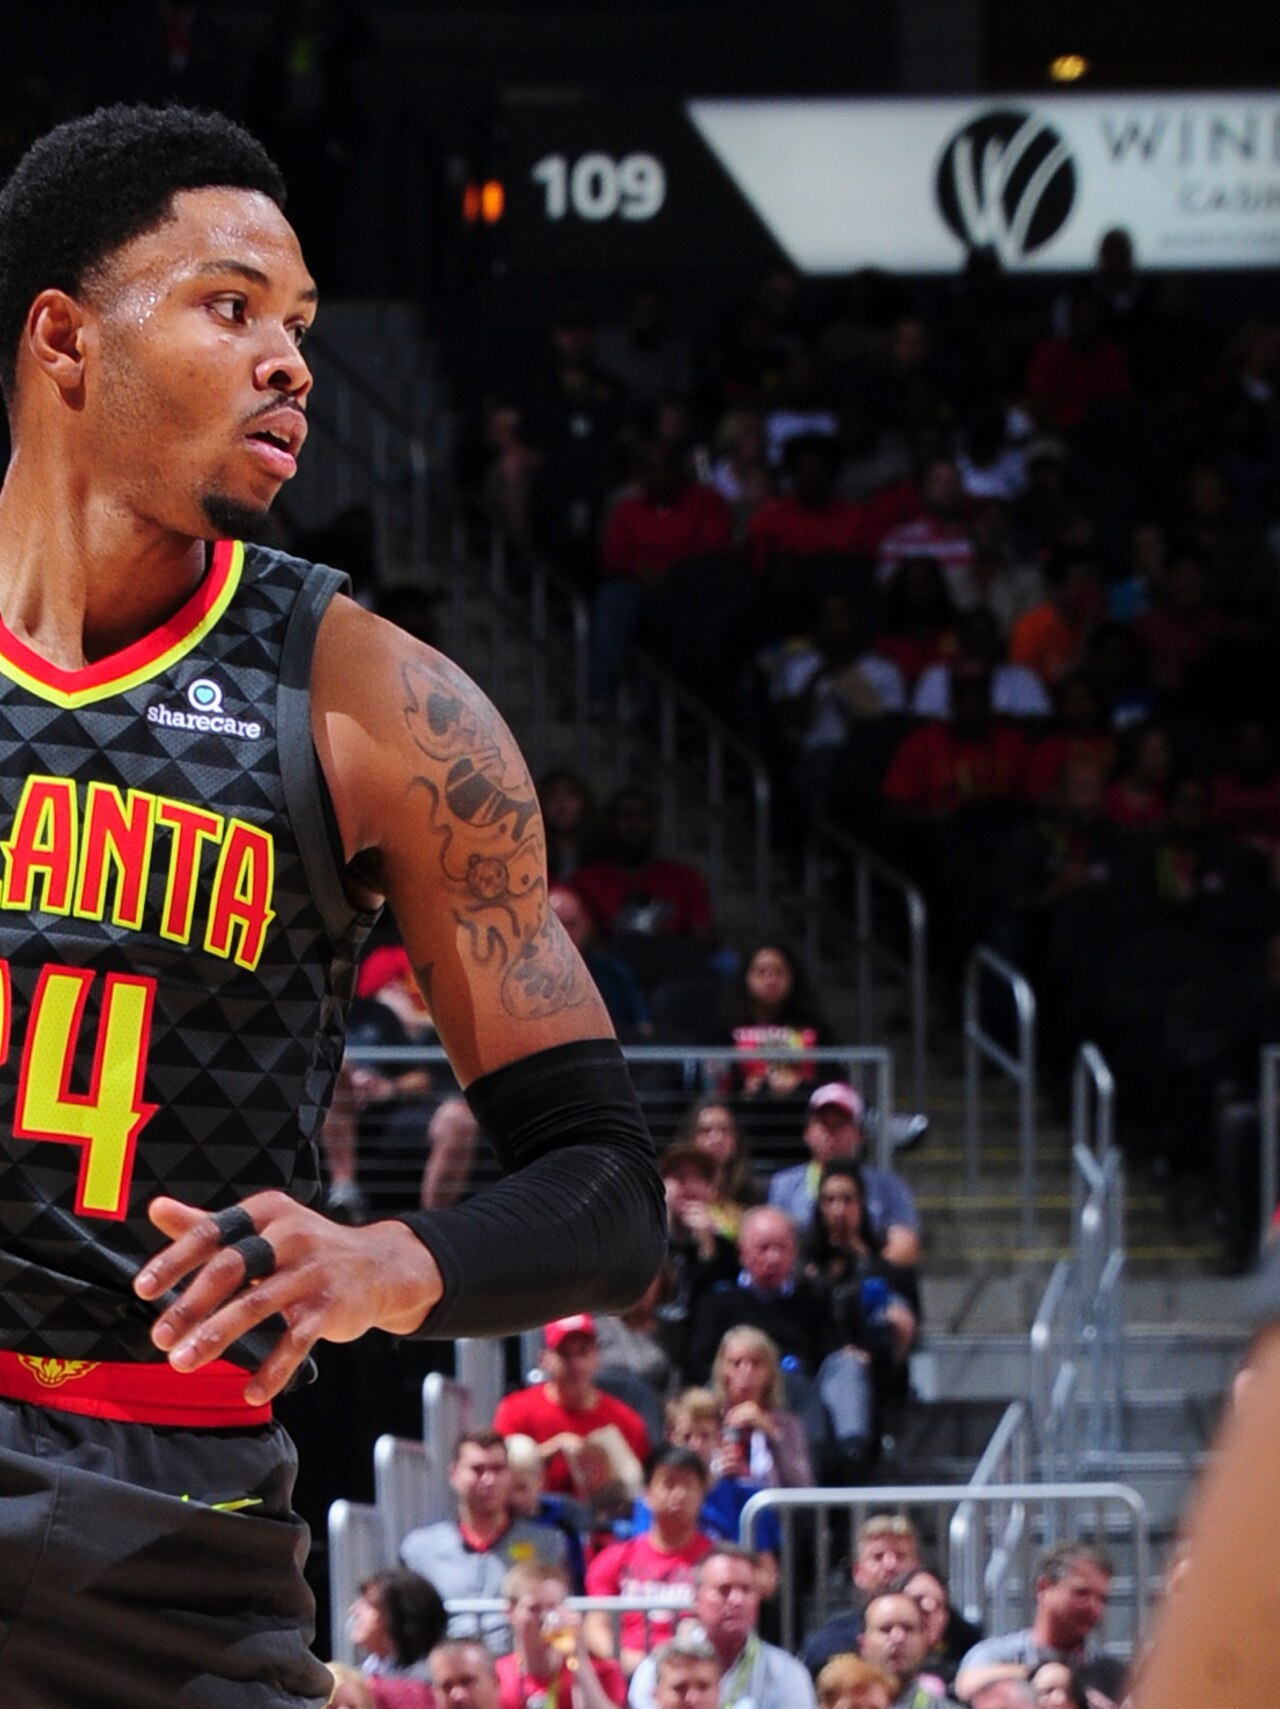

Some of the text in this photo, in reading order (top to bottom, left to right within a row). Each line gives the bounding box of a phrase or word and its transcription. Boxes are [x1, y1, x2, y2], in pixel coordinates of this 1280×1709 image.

[1098, 108, 1280, 166] WIN
[531, 153, 666, 222] 109
[147, 703, 261, 739] sharecare
